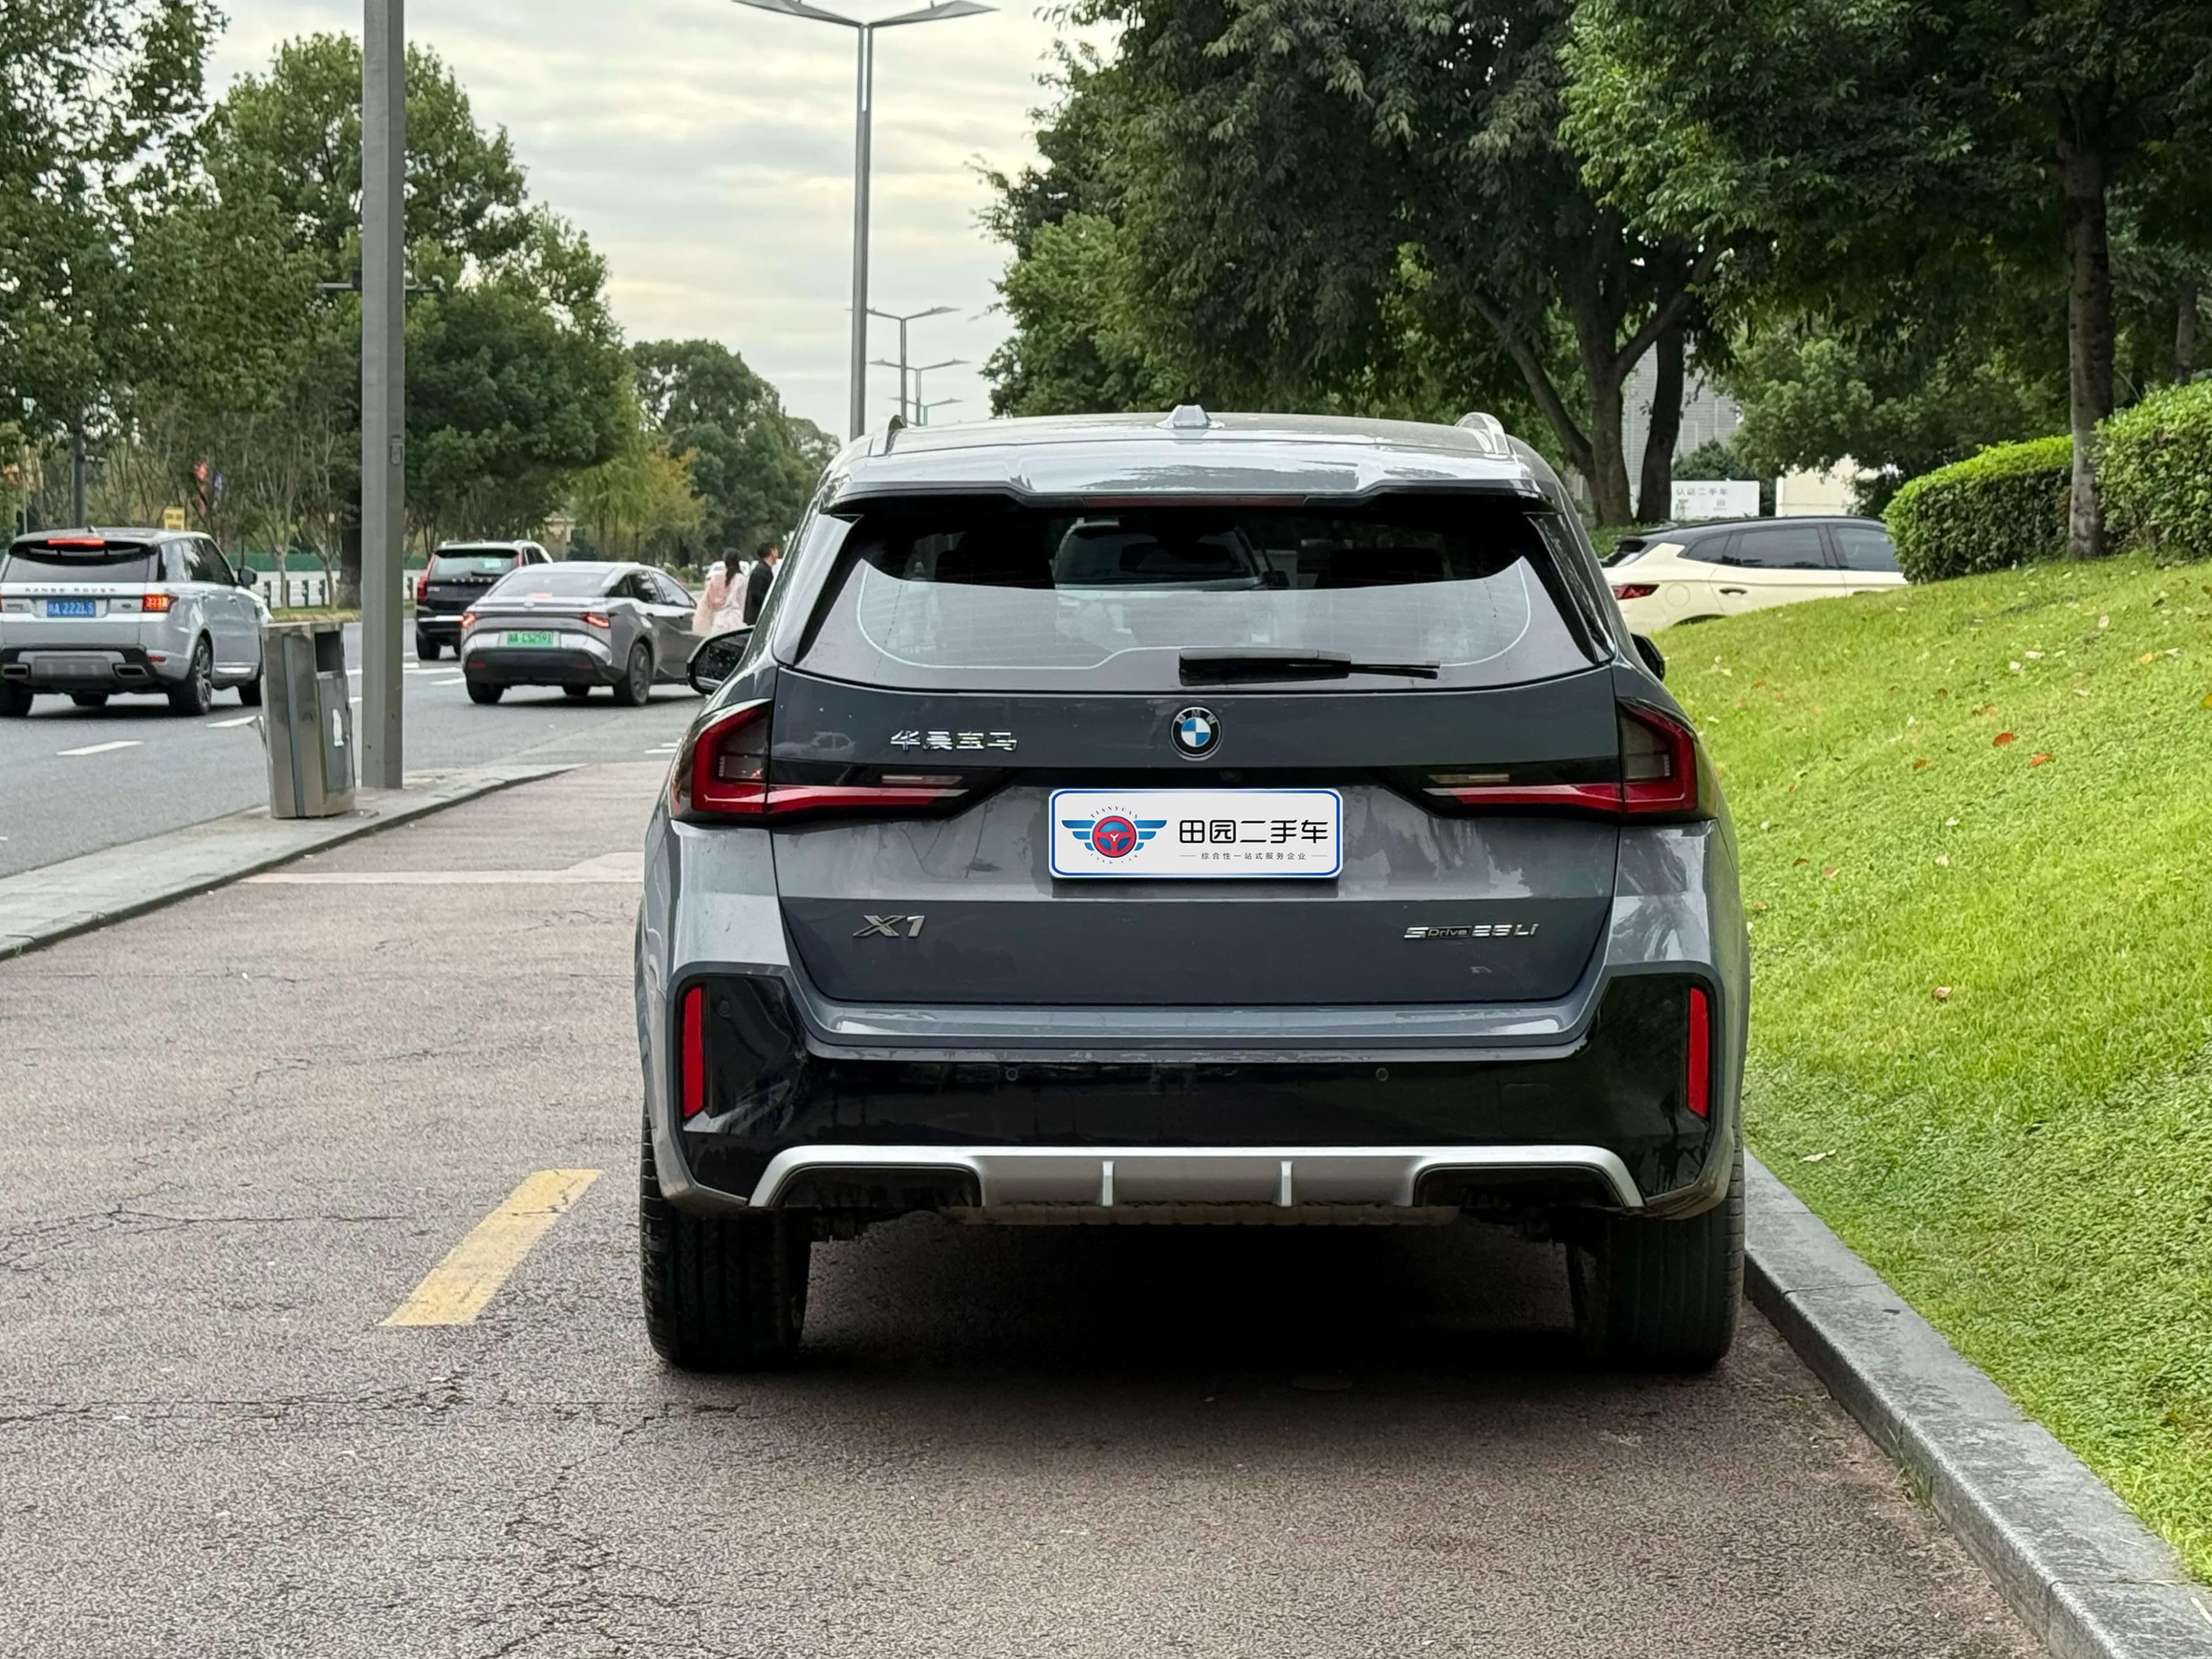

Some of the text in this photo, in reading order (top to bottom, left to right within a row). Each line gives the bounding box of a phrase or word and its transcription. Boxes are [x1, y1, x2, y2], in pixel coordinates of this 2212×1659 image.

[1176, 709, 1217, 725] BMW
[890, 730, 1017, 751] 华晨宝马
[1179, 819, 1328, 844] 田园二手车
[1201, 851, 1306, 860] 综合性一站式服务企业
[852, 915, 925, 938] X1
